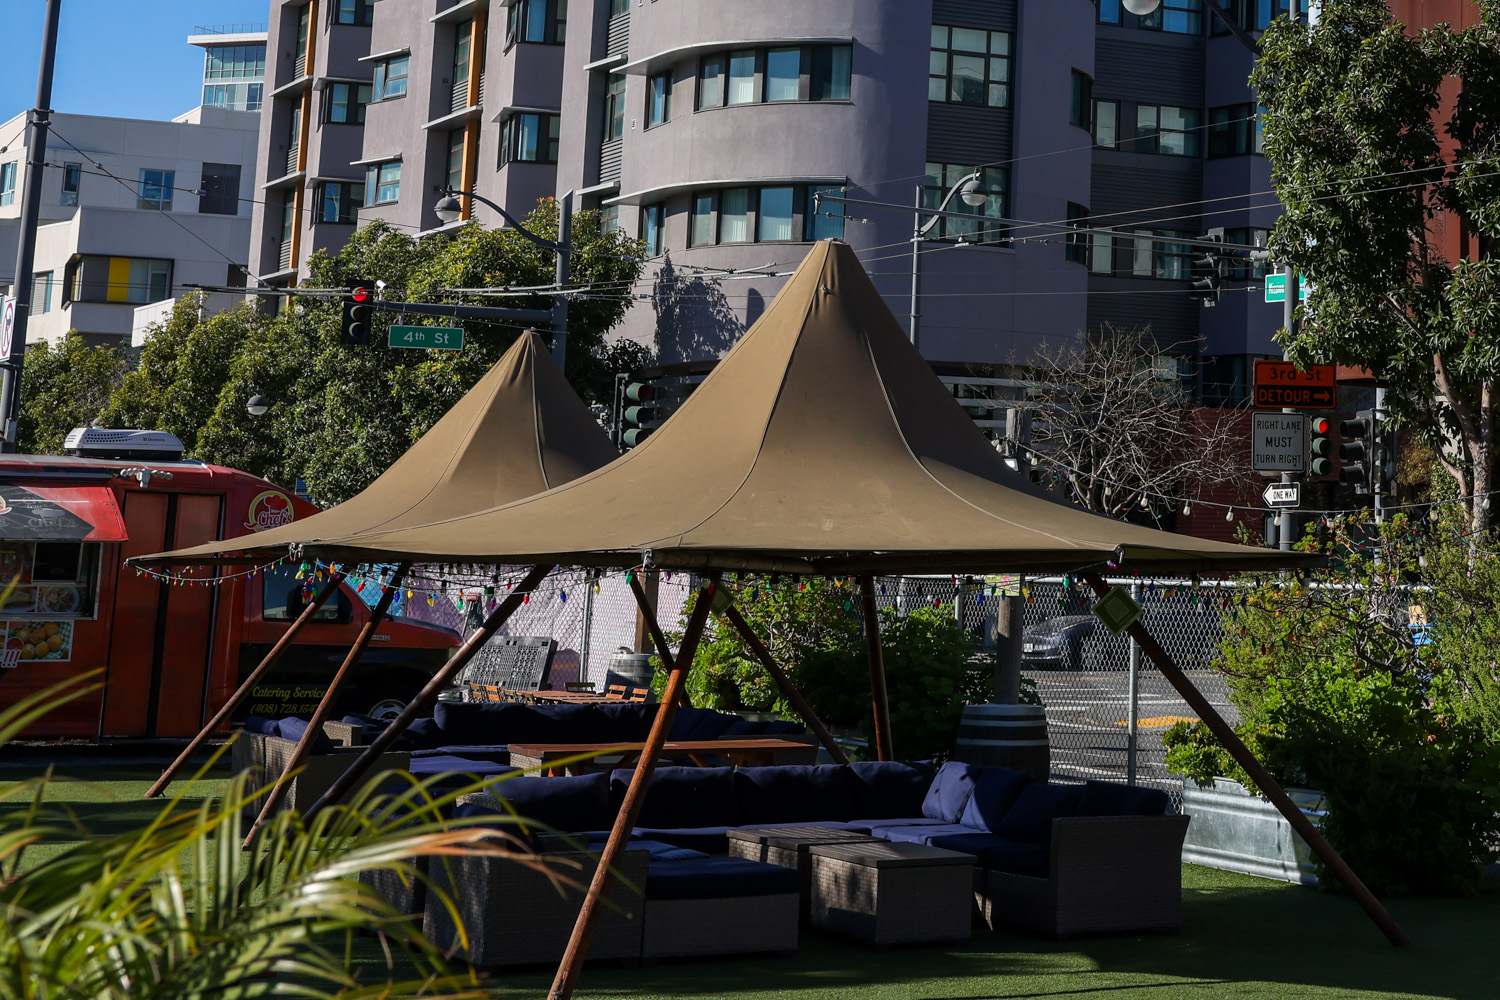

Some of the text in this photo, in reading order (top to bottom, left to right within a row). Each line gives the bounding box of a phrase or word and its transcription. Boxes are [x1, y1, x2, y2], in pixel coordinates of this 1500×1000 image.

[403, 331, 449, 344] 4th St
[1269, 367, 1322, 381] 3rd St
[1259, 389, 1311, 403] DETOUR
[1256, 420, 1302, 431] RIGHT LANE
[1265, 436, 1293, 448] MUST
[1256, 453, 1302, 464] TURN RIGHT
[1273, 490, 1296, 500] ONE WAY
[257, 511, 293, 527] Chef's
[252, 686, 291, 702] Catering
[250, 703, 278, 715] (408)
